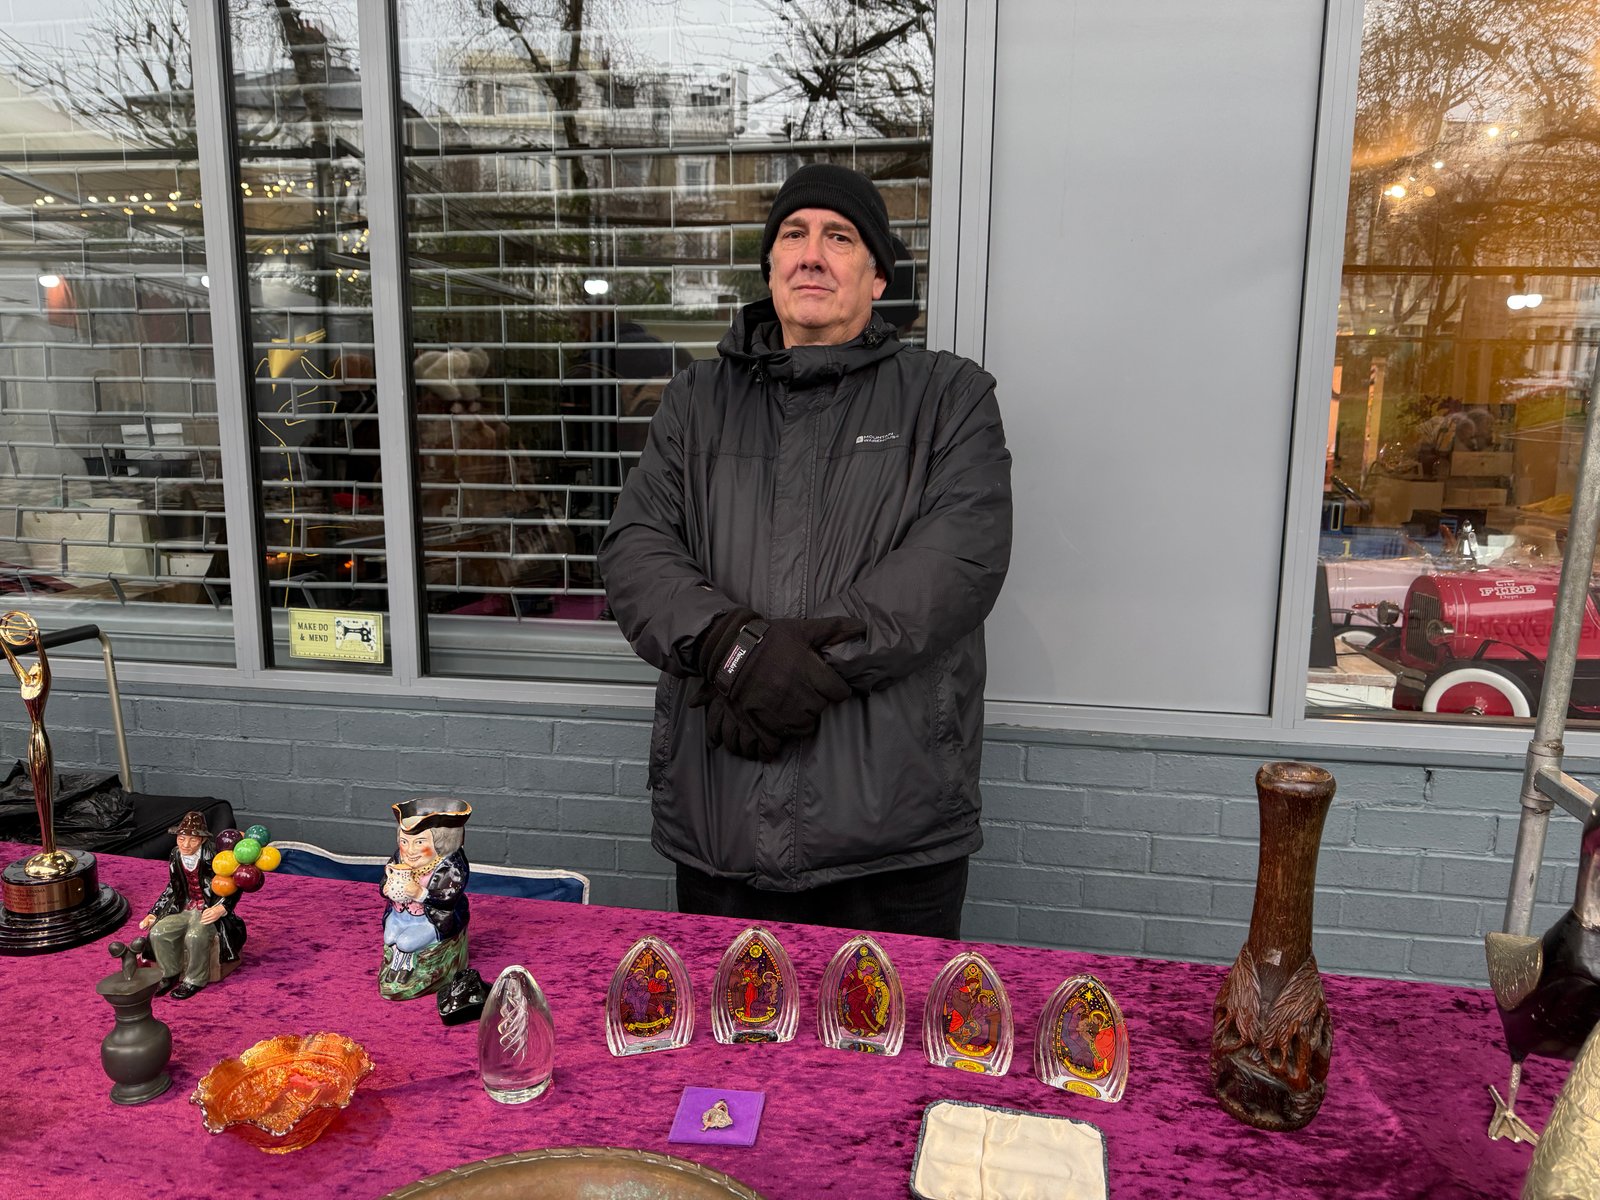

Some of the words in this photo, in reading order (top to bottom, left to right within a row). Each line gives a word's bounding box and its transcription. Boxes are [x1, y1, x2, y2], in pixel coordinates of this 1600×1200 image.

[1479, 585, 1536, 597] FIRE
[297, 622, 317, 631] MAKE
[318, 623, 329, 632] DO
[299, 633, 305, 641] &
[308, 634, 329, 642] MEND
[727, 648, 747, 674] Thinsulate
